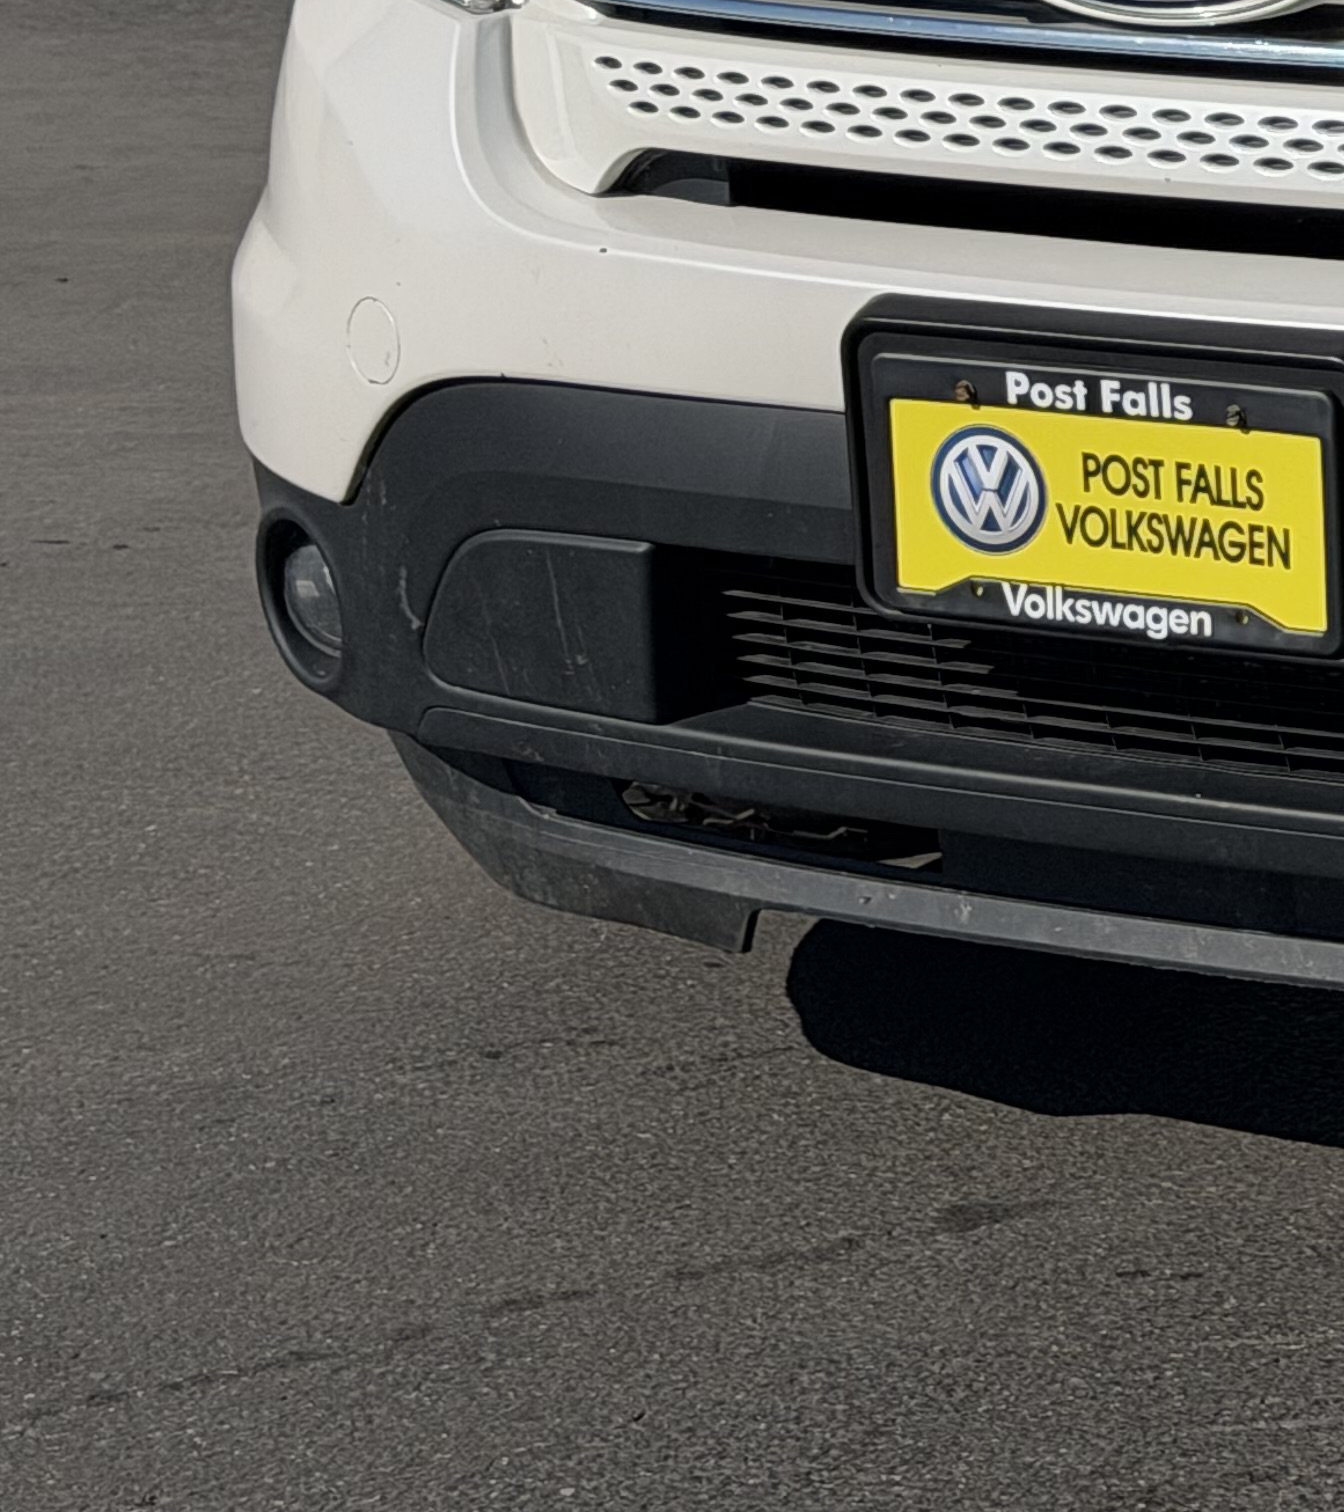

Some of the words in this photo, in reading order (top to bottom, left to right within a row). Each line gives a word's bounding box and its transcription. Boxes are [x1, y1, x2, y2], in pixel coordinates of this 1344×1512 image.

[1005, 370, 1088, 412] Post
[1100, 379, 1194, 422] Falls
[1081, 452, 1166, 501] POST
[1174, 461, 1265, 511] FALLS
[1055, 502, 1291, 570] VOLKSWAGEN
[1000, 581, 1212, 640] Volkswagen
